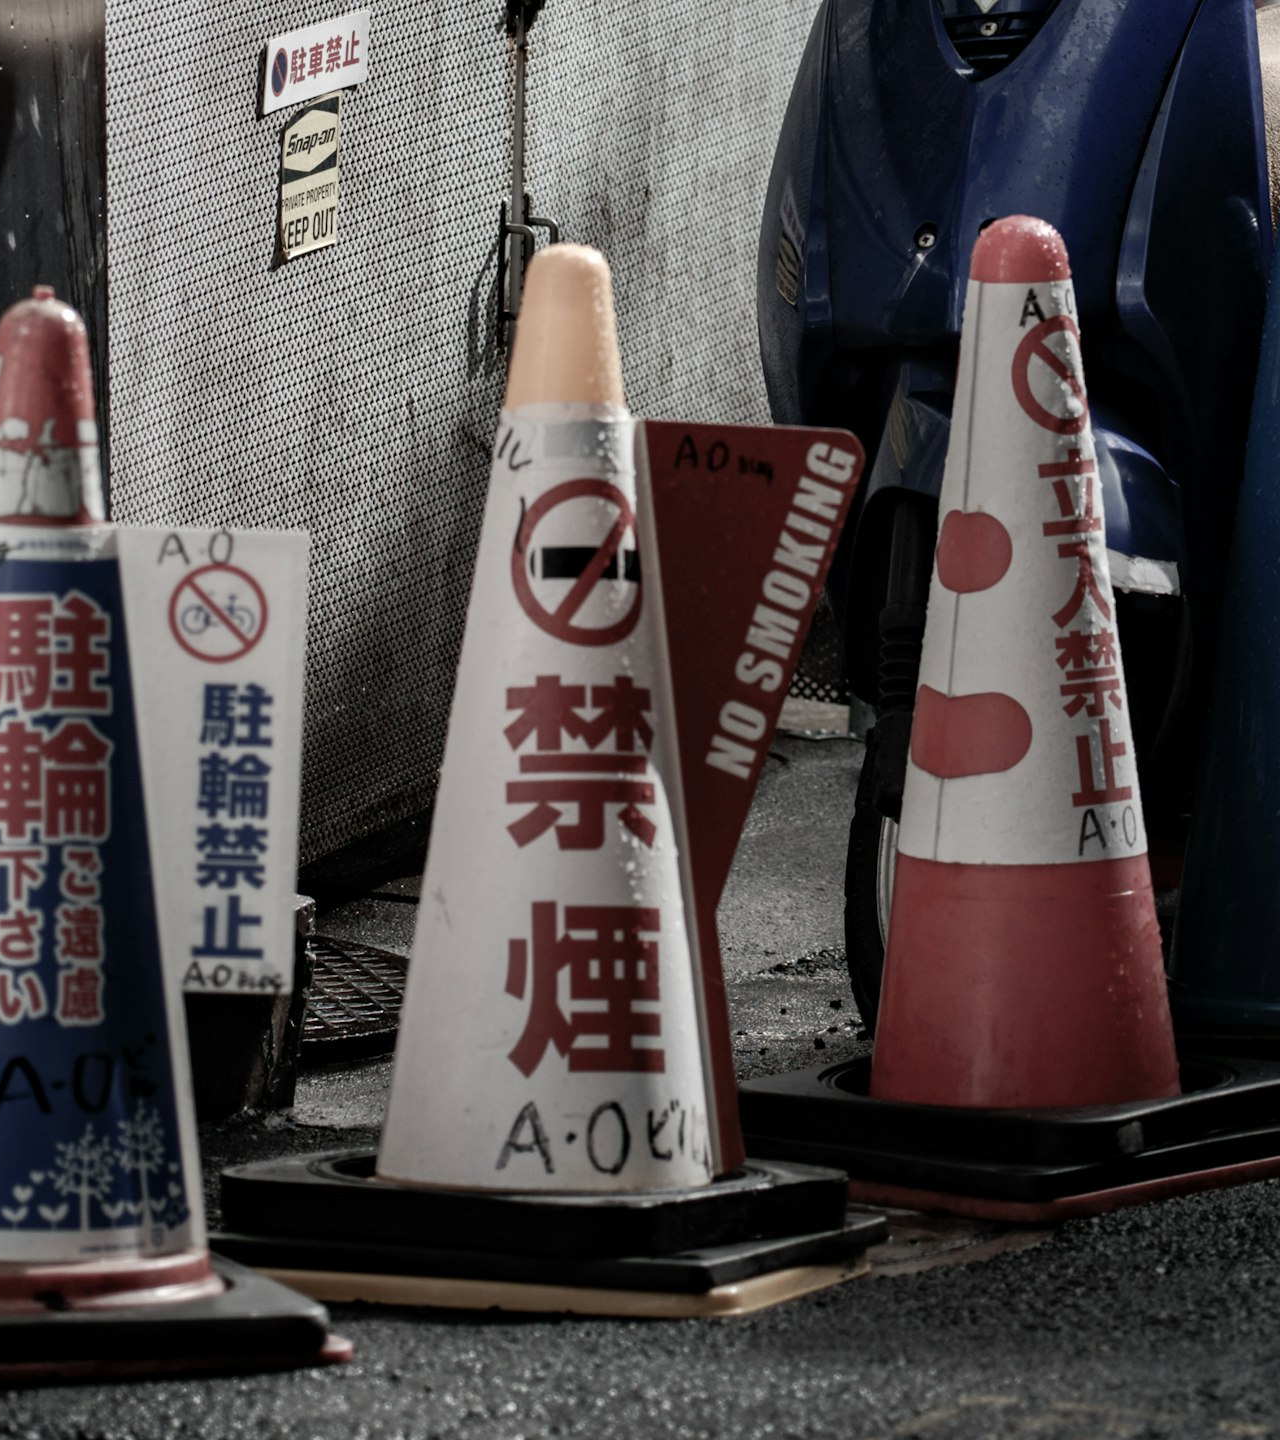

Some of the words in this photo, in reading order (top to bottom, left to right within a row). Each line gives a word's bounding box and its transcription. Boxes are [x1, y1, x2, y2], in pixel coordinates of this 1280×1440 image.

[289, 30, 360, 85] 駐車禁止
[282, 191, 306, 213] PRIVATE
[306, 180, 337, 206] PROPERTY
[286, 126, 336, 158] Snap-on
[312, 206, 337, 241] OUT
[734, 441, 857, 694] SMOKING
[1037, 448, 1134, 809] 立入禁止
[704, 699, 767, 781] NO
[190, 682, 274, 960] 駐輪禁止
[503, 673, 667, 1079] 禁煙
[55, 845, 105, 1025] ご遠慮
